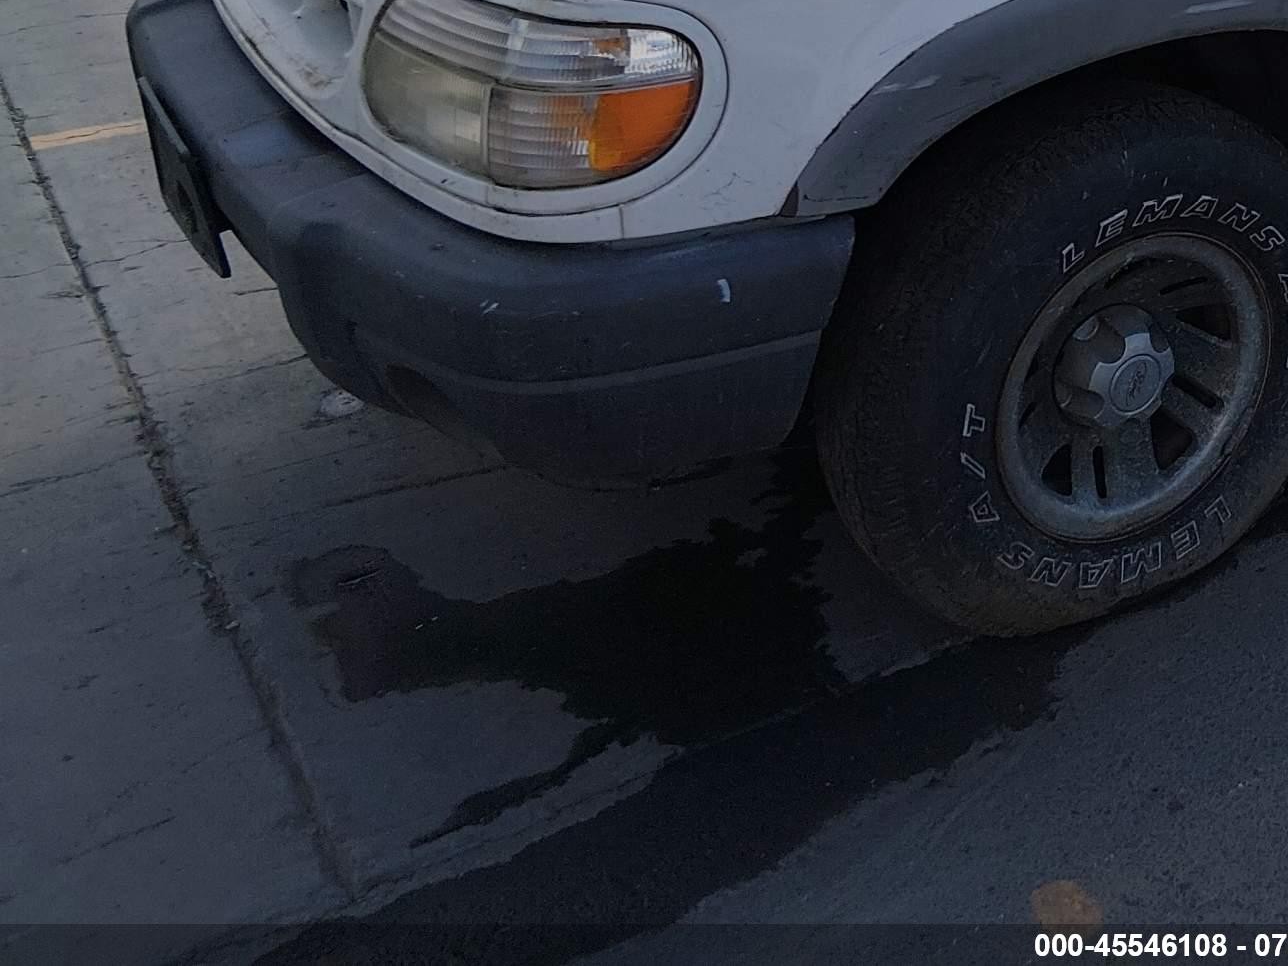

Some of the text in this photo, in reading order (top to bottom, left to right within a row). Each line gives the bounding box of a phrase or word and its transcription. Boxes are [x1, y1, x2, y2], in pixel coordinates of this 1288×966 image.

[1061, 194, 1286, 274] LEMANS
[961, 403, 1234, 589] LEMANS A/T
